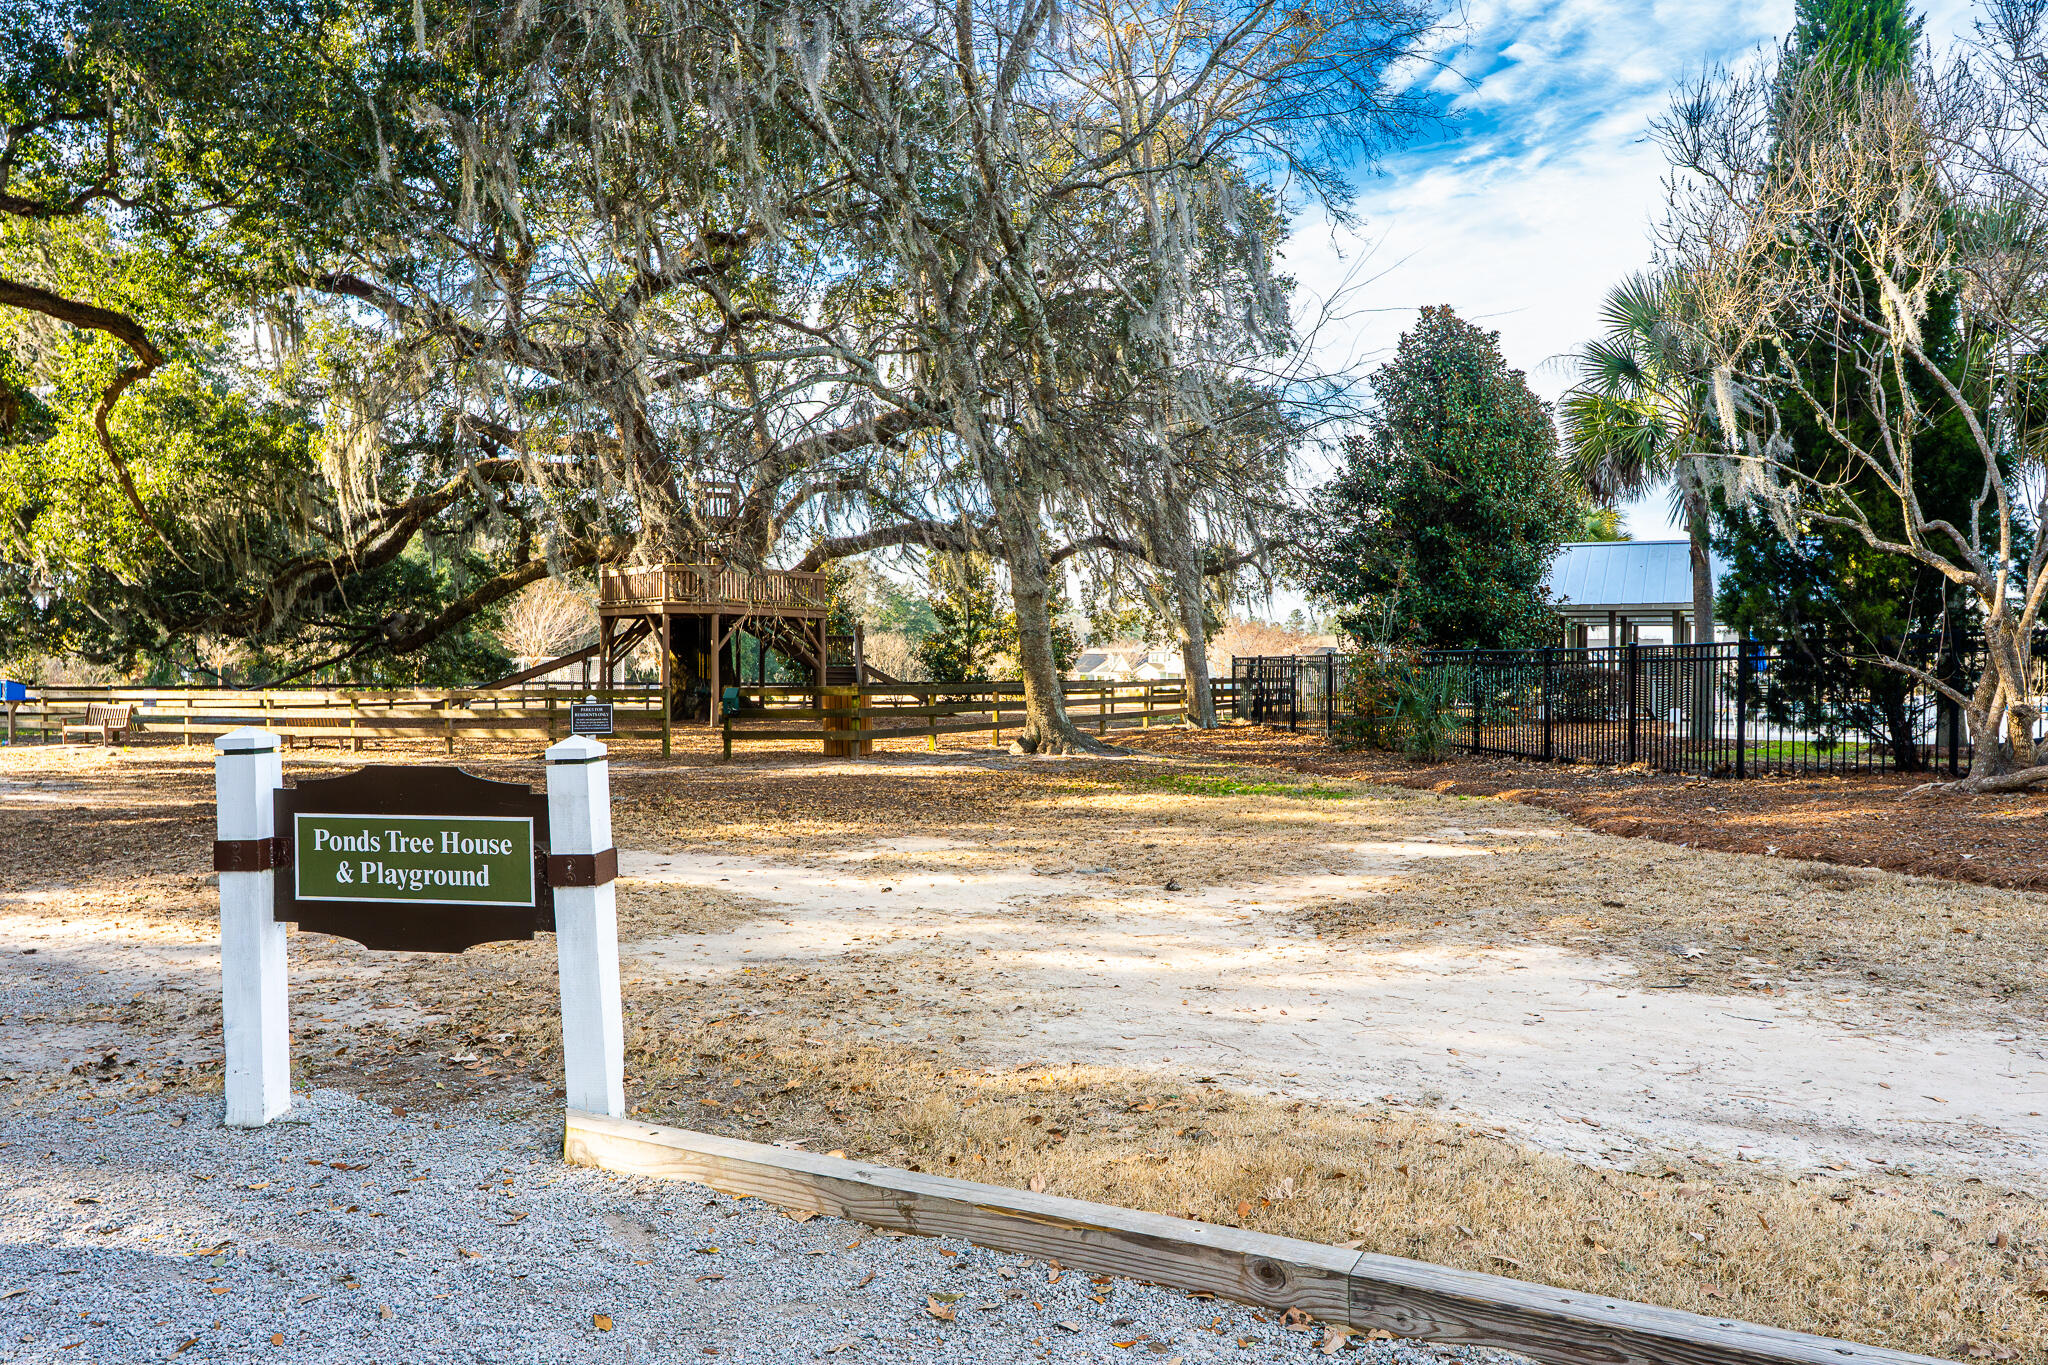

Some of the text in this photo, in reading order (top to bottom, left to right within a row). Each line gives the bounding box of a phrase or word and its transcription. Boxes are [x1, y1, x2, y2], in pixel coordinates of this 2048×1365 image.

[313, 828, 513, 855] Ponds Tree House
[335, 860, 490, 891] & Playground
